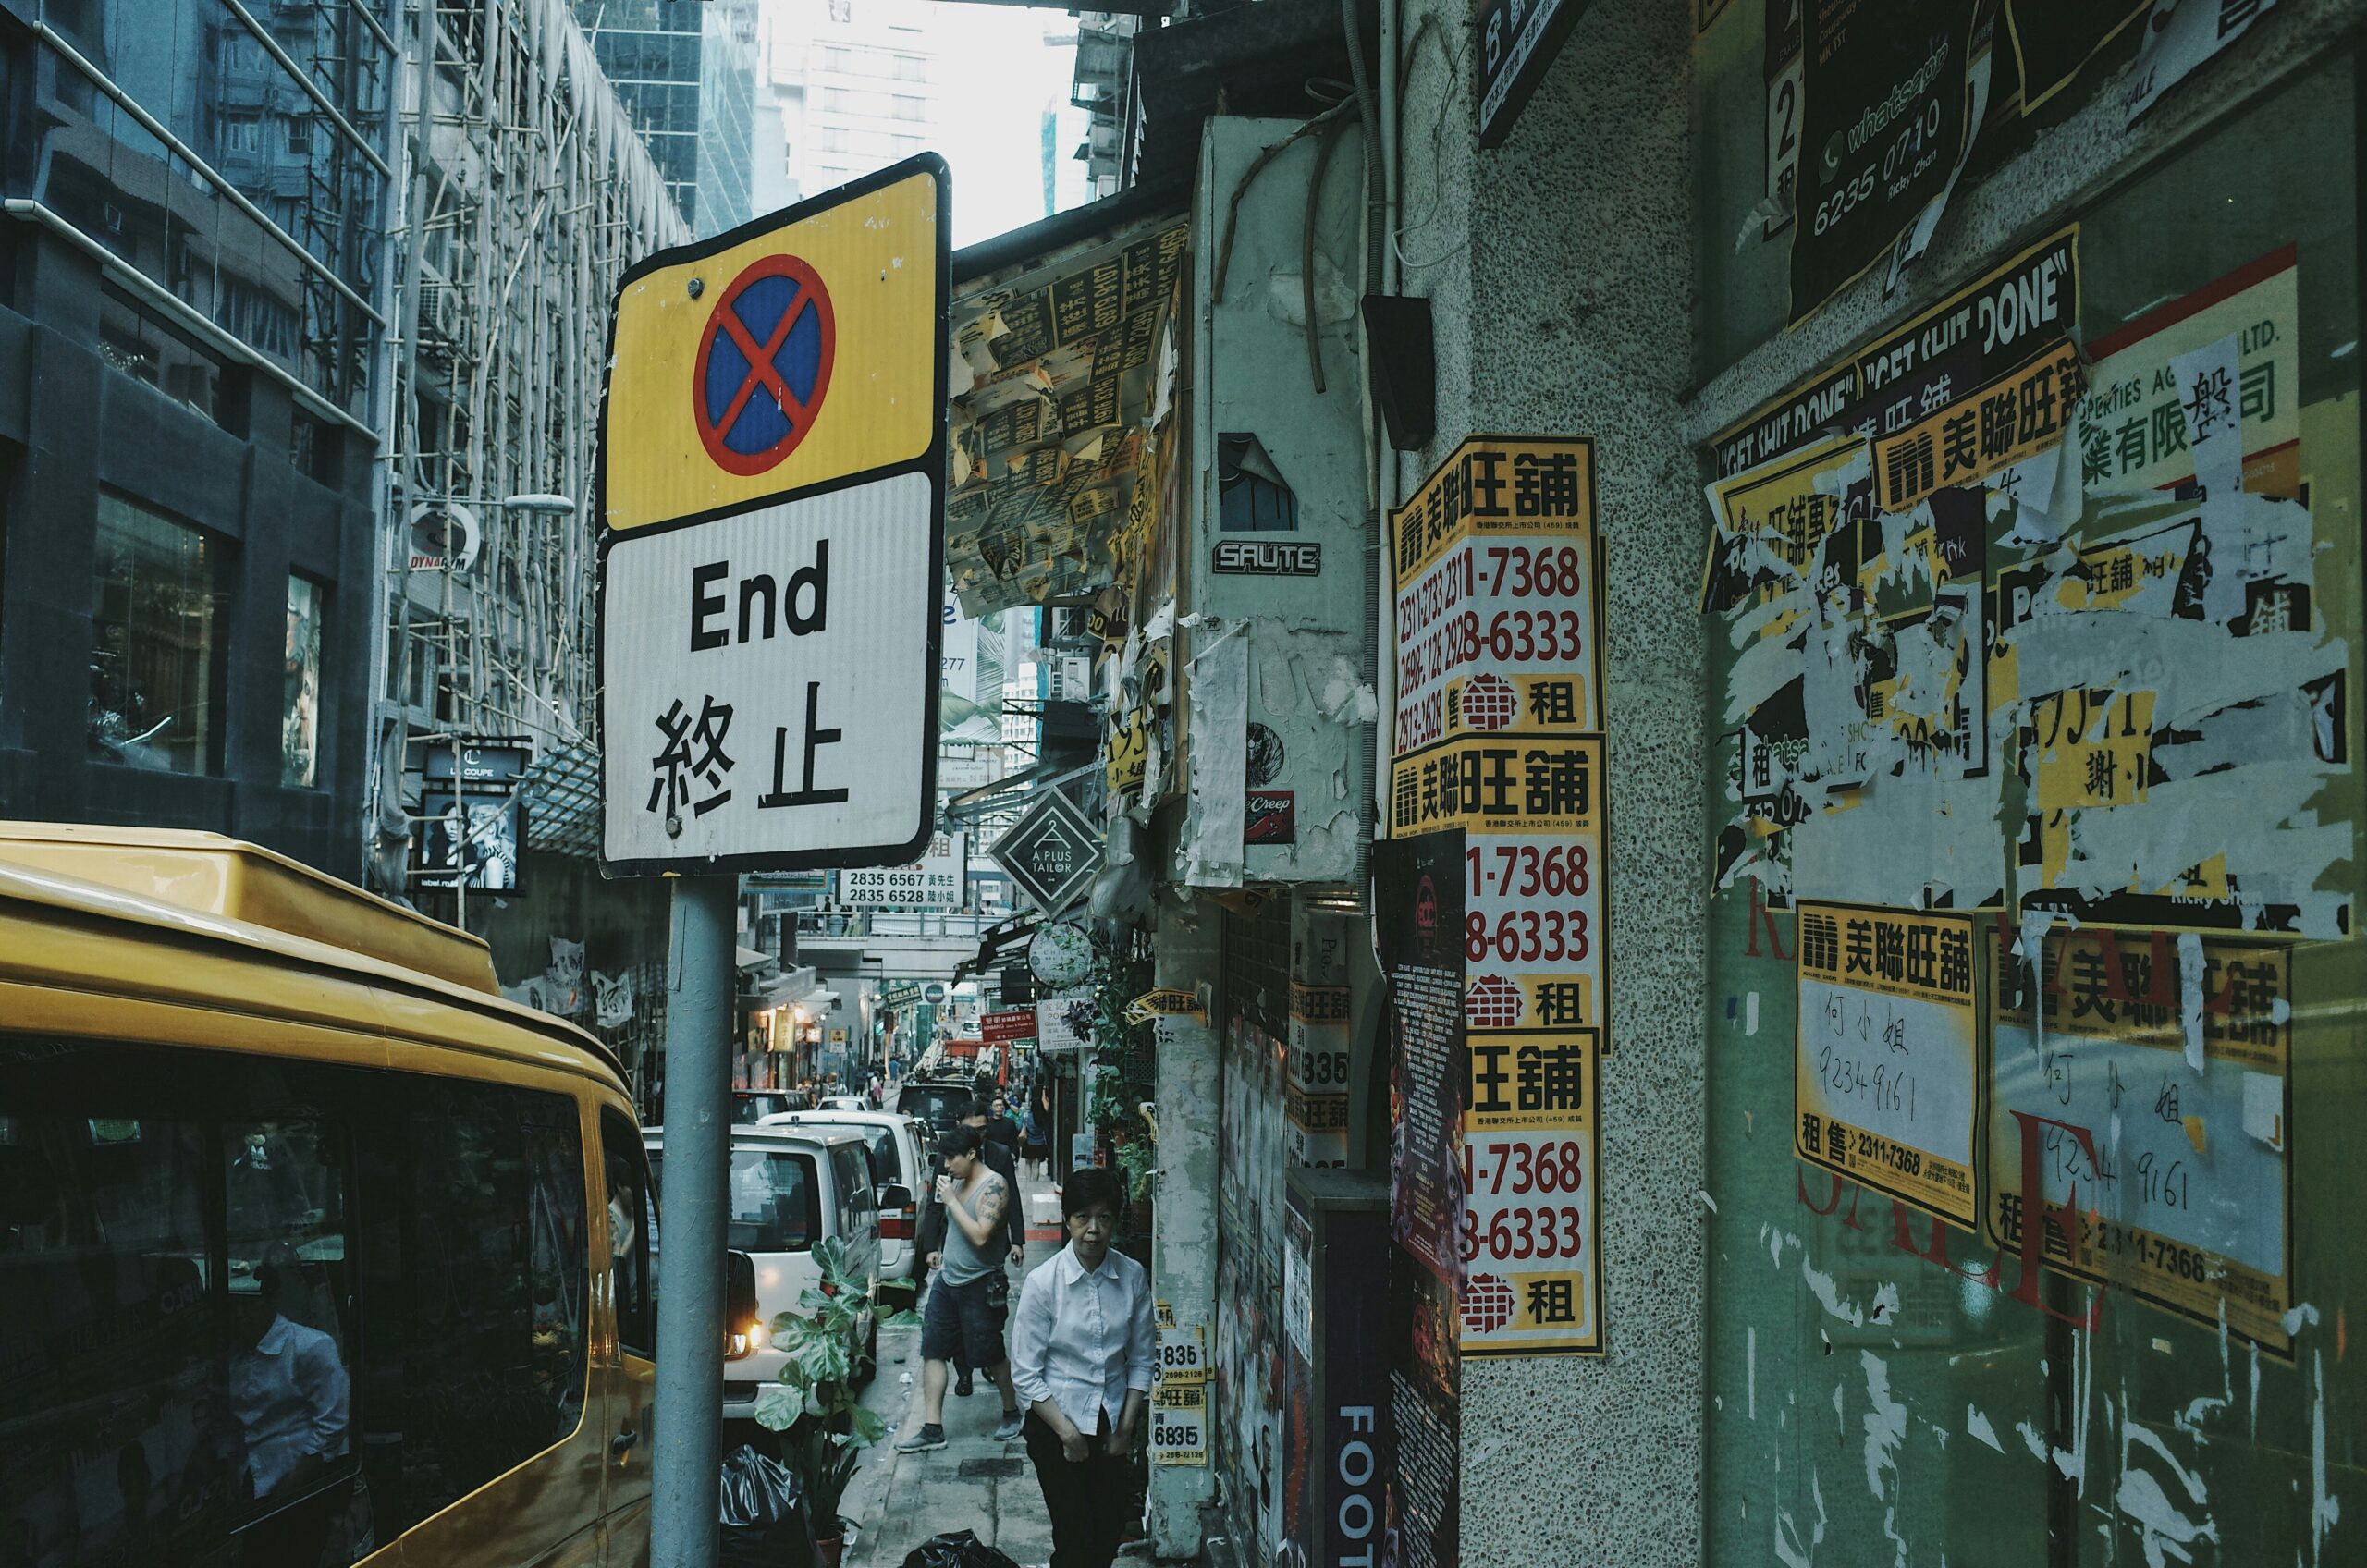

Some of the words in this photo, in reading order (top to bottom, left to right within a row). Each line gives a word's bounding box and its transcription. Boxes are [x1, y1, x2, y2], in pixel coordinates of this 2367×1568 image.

[1848, 42, 1949, 155] whatsapp
[1813, 162, 1877, 237] 6235
[1883, 97, 1941, 182] 0710
[1886, 170, 1912, 202] Ricky
[1912, 149, 1937, 179] Chan
[1093, 263, 1119, 298] 9107
[1094, 295, 1119, 329] 6979
[2242, 319, 2281, 356] LTD.
[1426, 451, 1579, 553] 美聯旺舖
[1220, 544, 1318, 569] SAUTE
[691, 538, 830, 653] End
[1400, 569, 1443, 644] 2311-2733
[1444, 545, 1582, 611] 2311-7368
[1444, 610, 1583, 672] 2928-6333
[1529, 680, 1577, 726] 租
[463, 767, 494, 778] COUPE
[646, 681, 850, 825] 終止
[1421, 748, 1590, 823] 美聯旺舖
[929, 837, 951, 858] 租
[1032, 851, 1041, 861] A
[1044, 851, 1072, 862] PLUS
[1032, 862, 1072, 873] TAILOR
[849, 888, 885, 902] 2835
[889, 889, 924, 903] 6528
[850, 872, 885, 886] 2835
[889, 873, 925, 887] 6567
[927, 874, 955, 887] 黃先生
[1846, 918, 1971, 994] 美聯旺舖
[1535, 982, 1584, 1026] 租
[1824, 990, 1909, 1056] 何小姐
[2070, 948, 2278, 1048] 美聯舖
[1802, 1112, 1821, 1155] 租
[1827, 1121, 1846, 1165] 售
[1858, 1133, 1921, 1177] 2311-7368
[2137, 1152, 2188, 1211] 9161
[1527, 1279, 1576, 1325] 租
